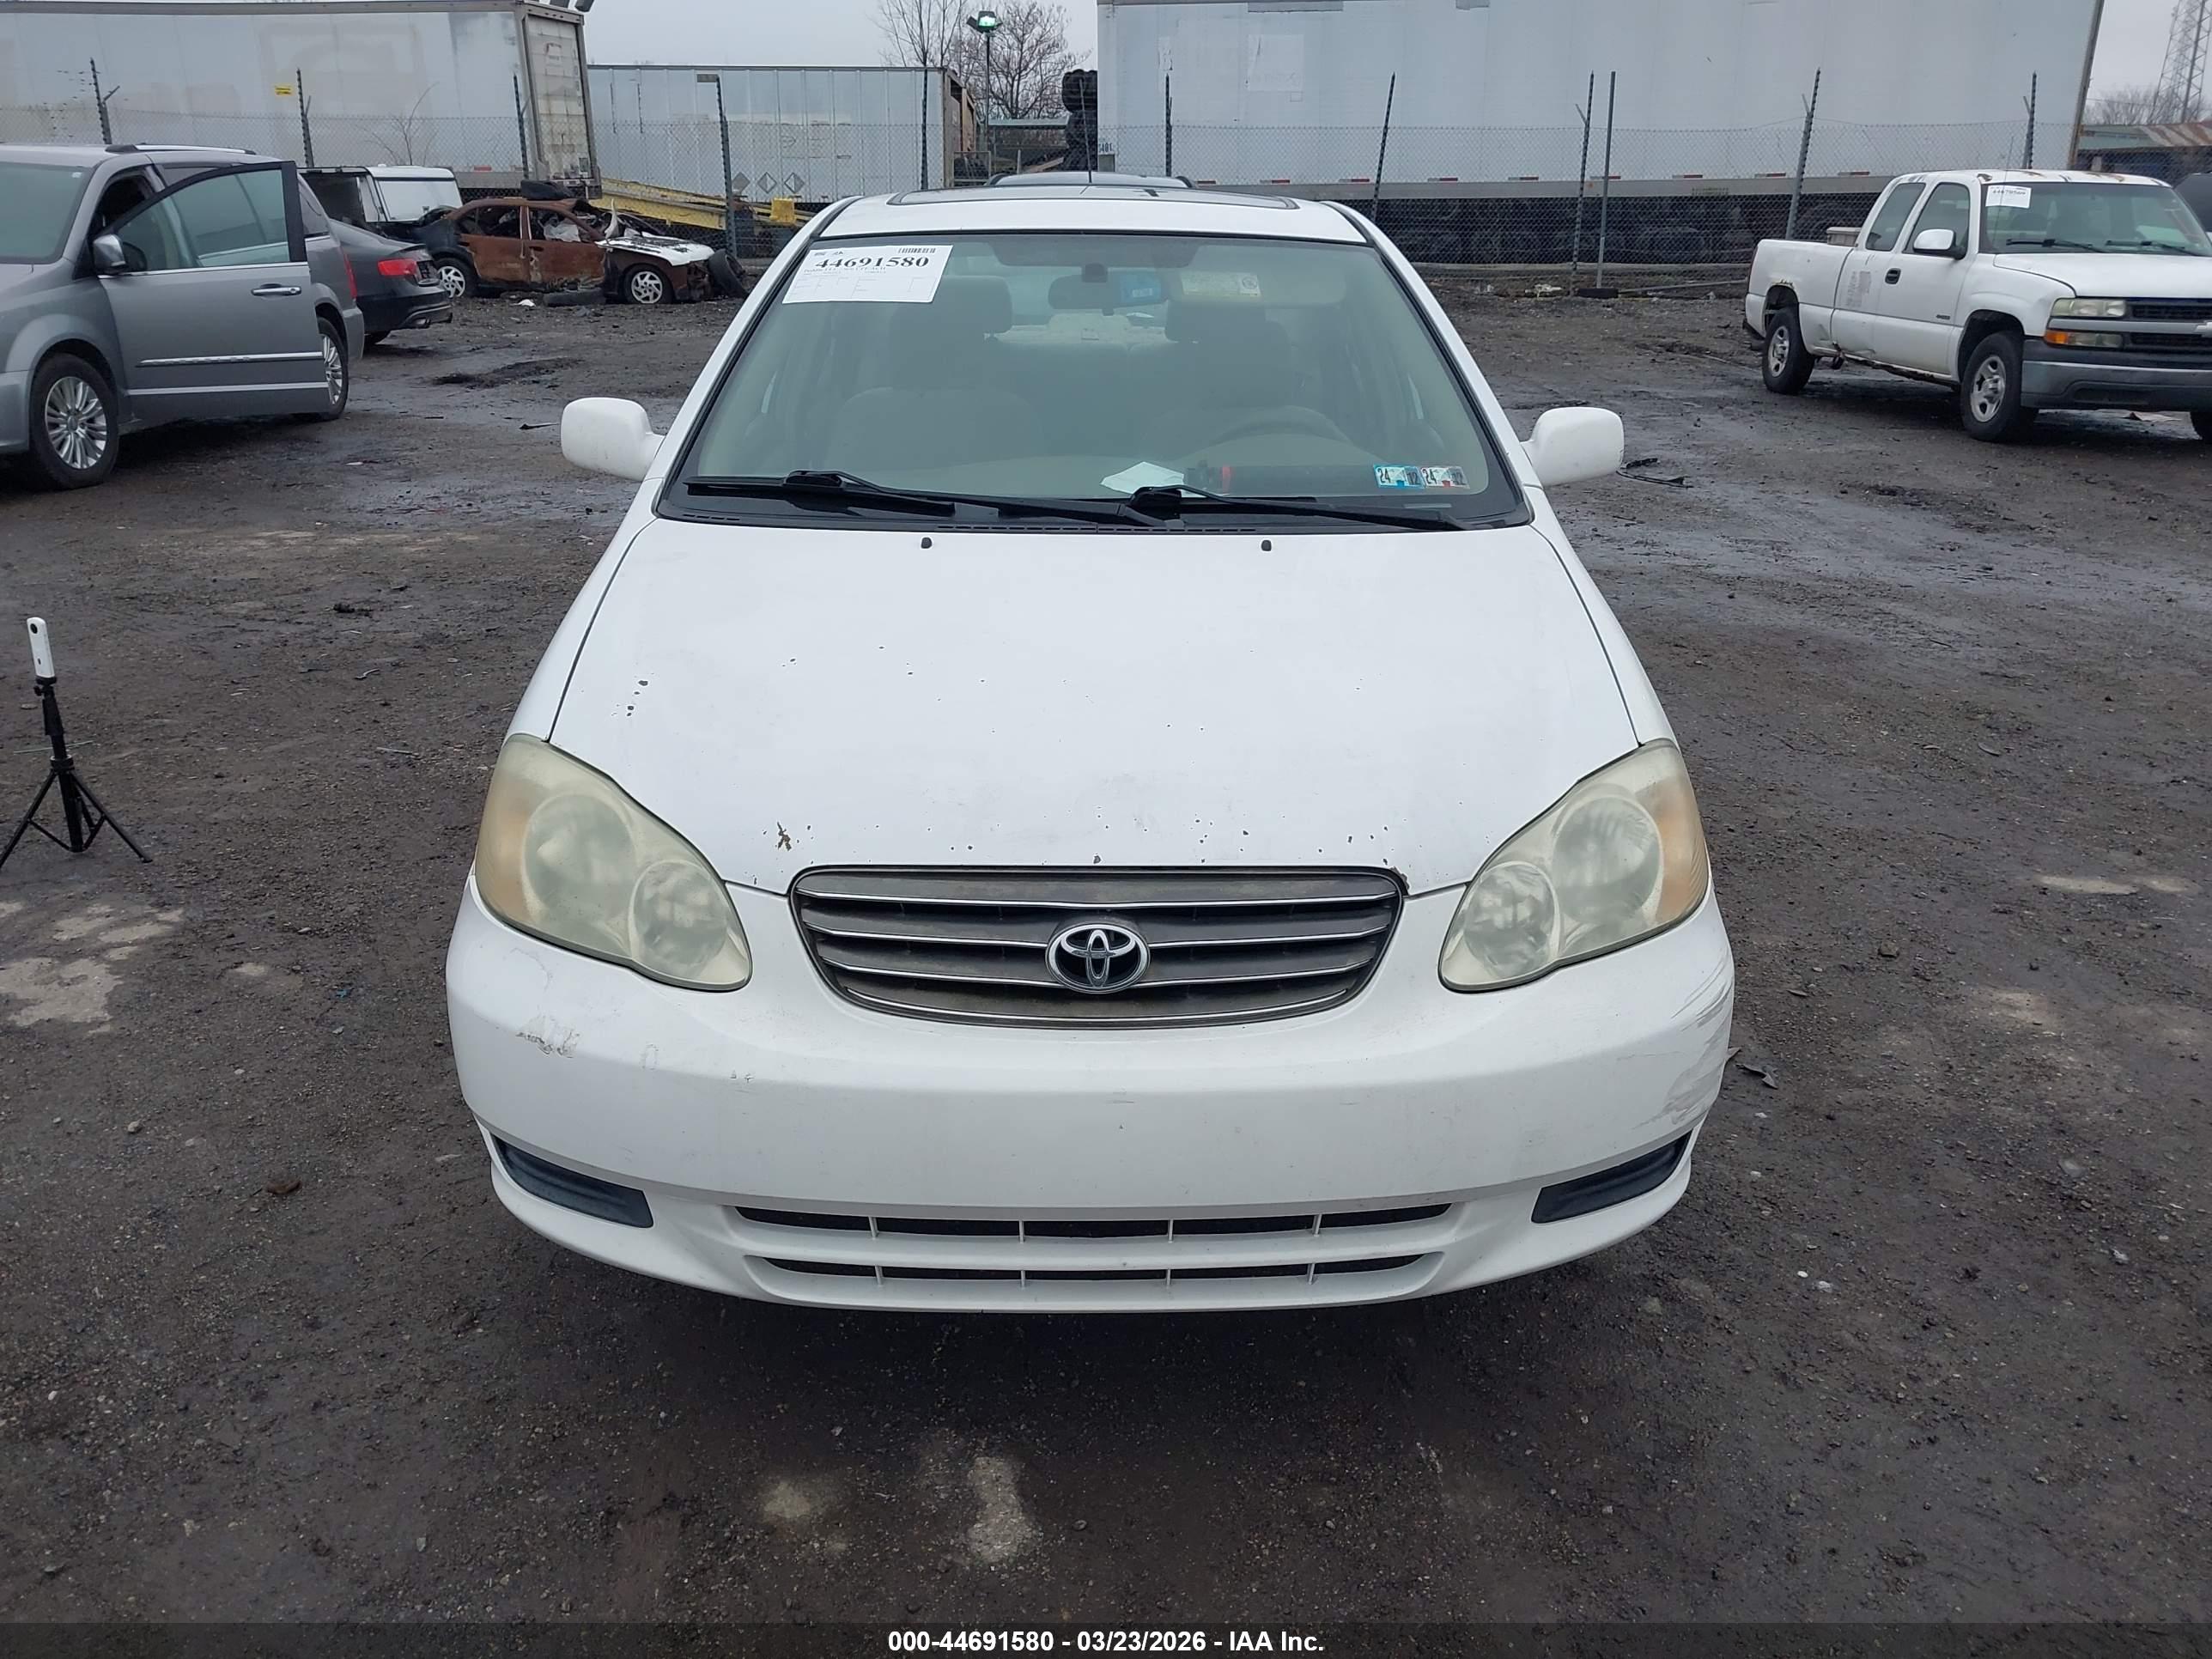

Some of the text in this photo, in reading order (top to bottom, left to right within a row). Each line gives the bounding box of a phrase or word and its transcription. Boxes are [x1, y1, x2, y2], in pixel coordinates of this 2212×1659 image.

[815, 257, 929, 269] 44691580
[1376, 468, 1391, 483] 24
[1422, 468, 1437, 484] 24
